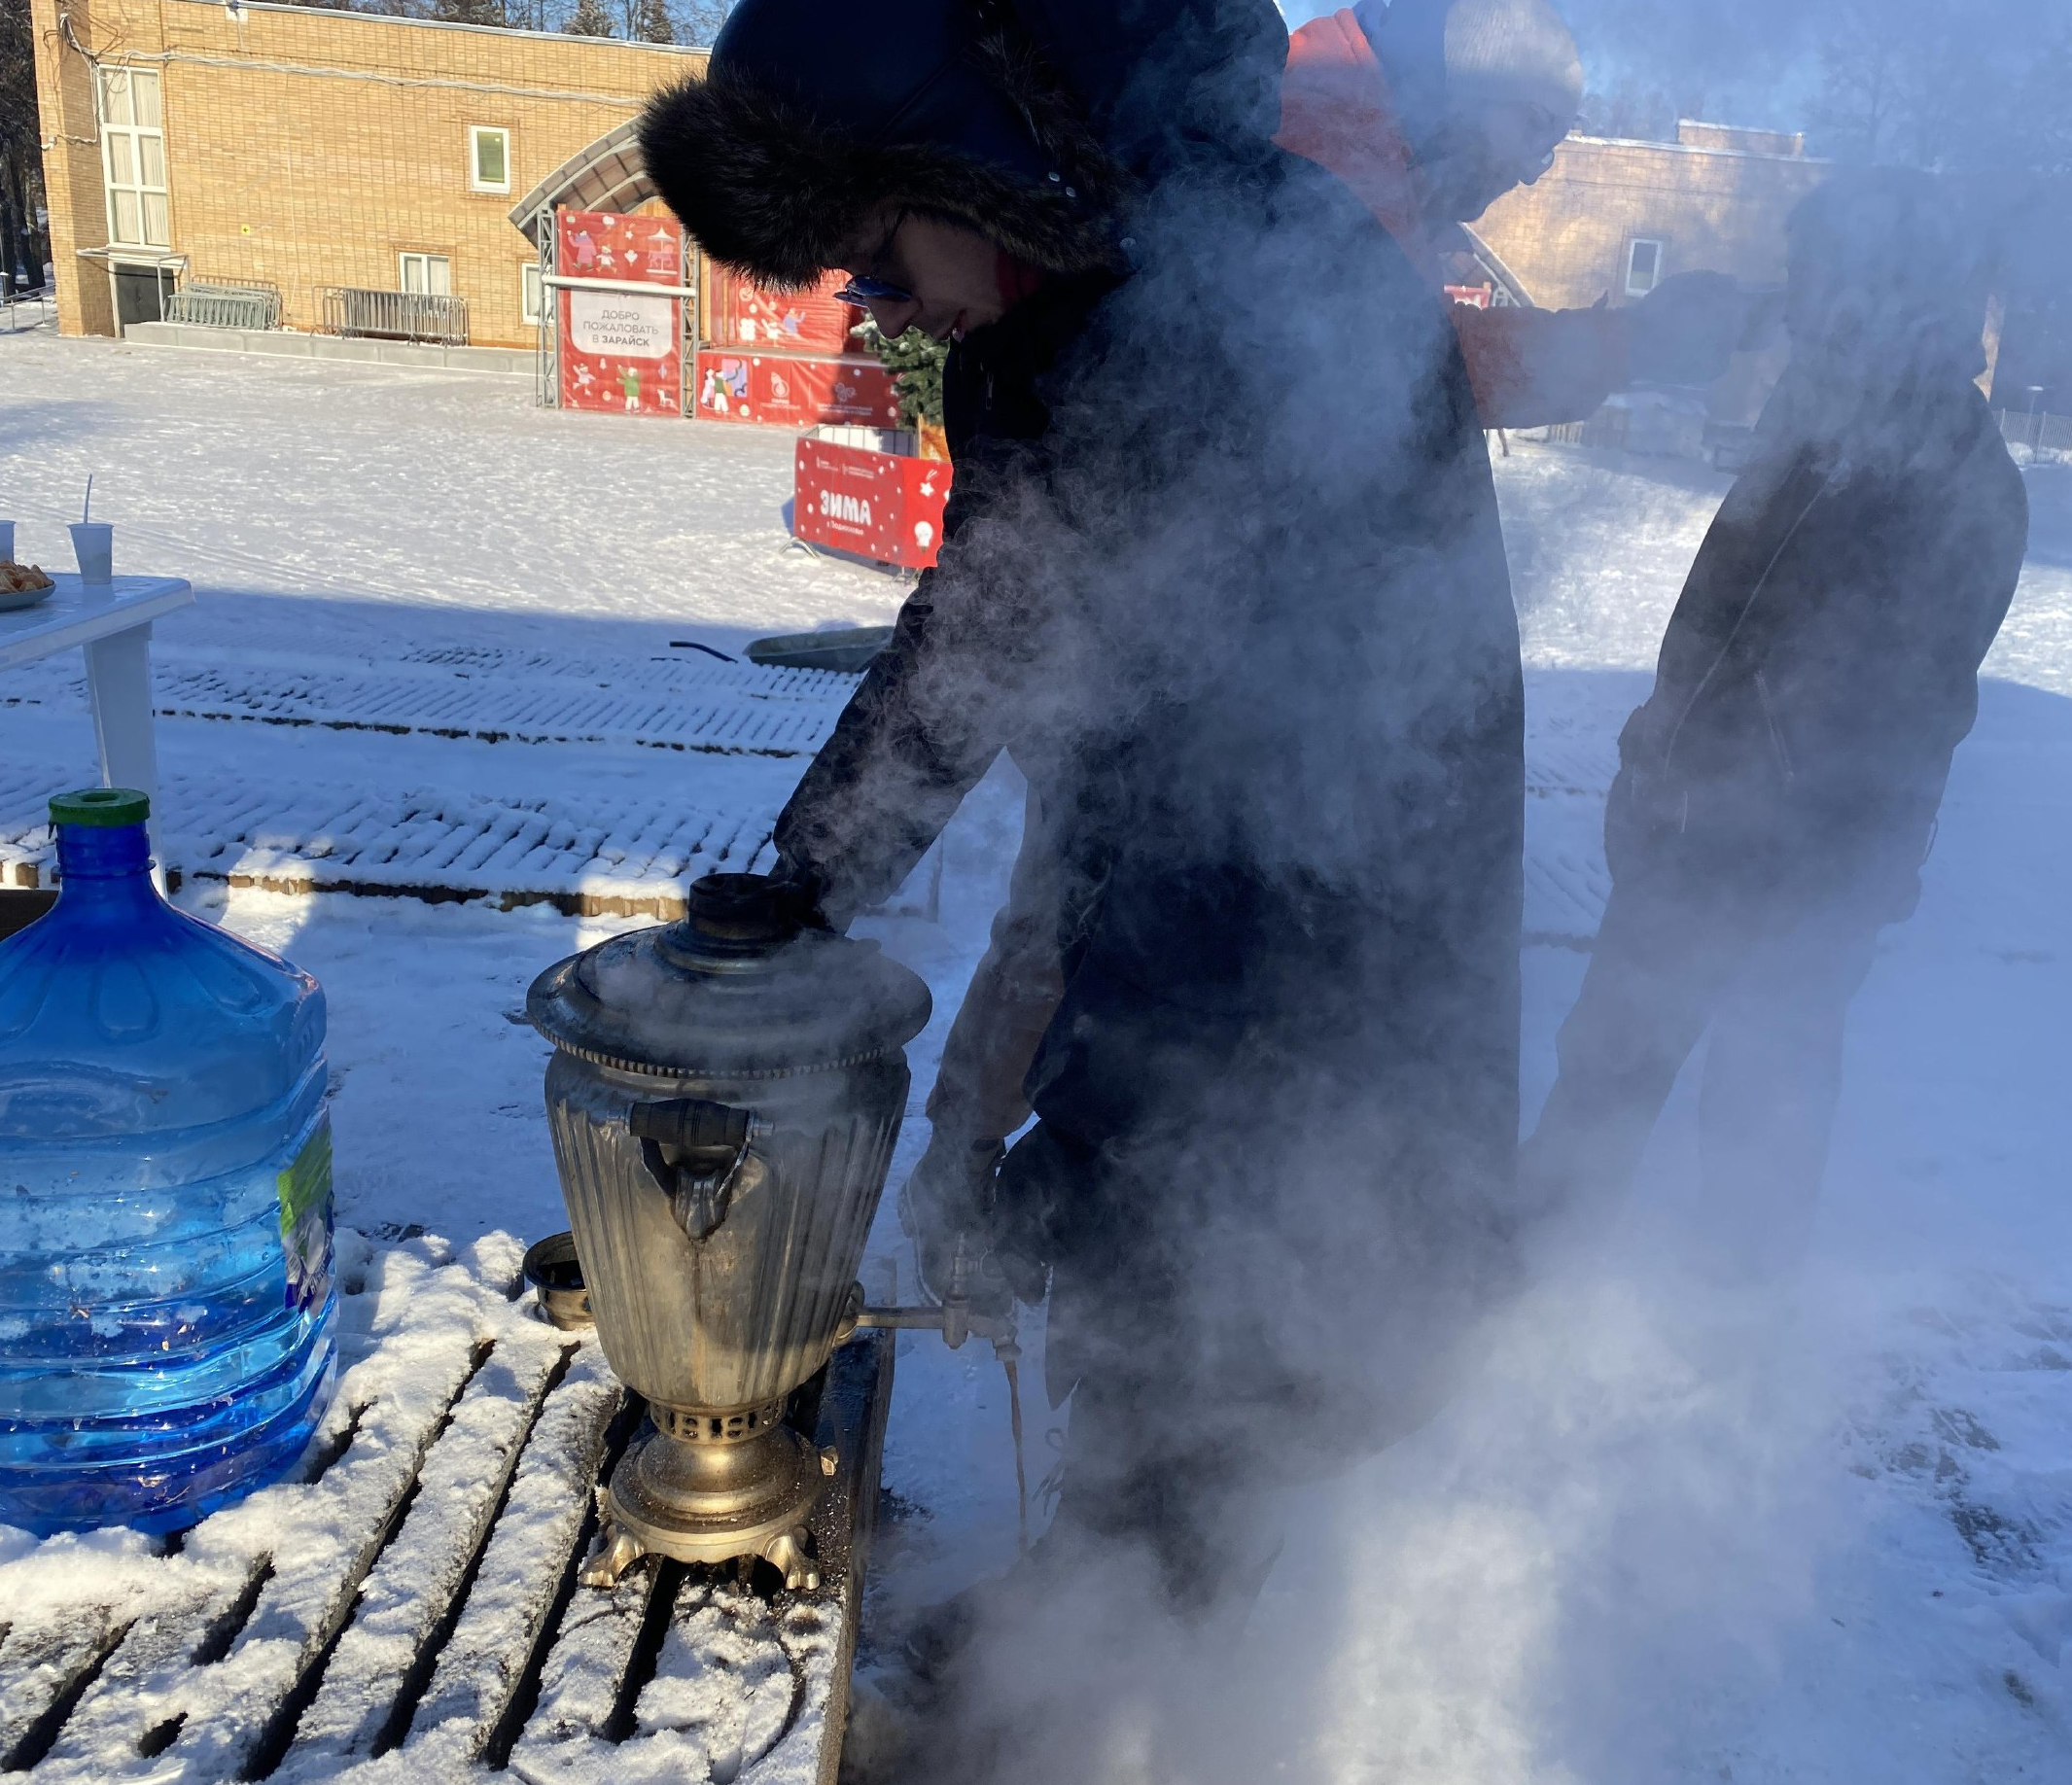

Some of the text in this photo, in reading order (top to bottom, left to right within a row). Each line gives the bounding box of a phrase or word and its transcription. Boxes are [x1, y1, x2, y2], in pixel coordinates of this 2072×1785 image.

[601, 309, 640, 321] ДОБРО
[582, 320, 659, 335] ПОЖАЛОВАТЬ
[592, 333, 650, 347] В ЗАРАЙСК
[820, 489, 872, 527] ЗИМА
